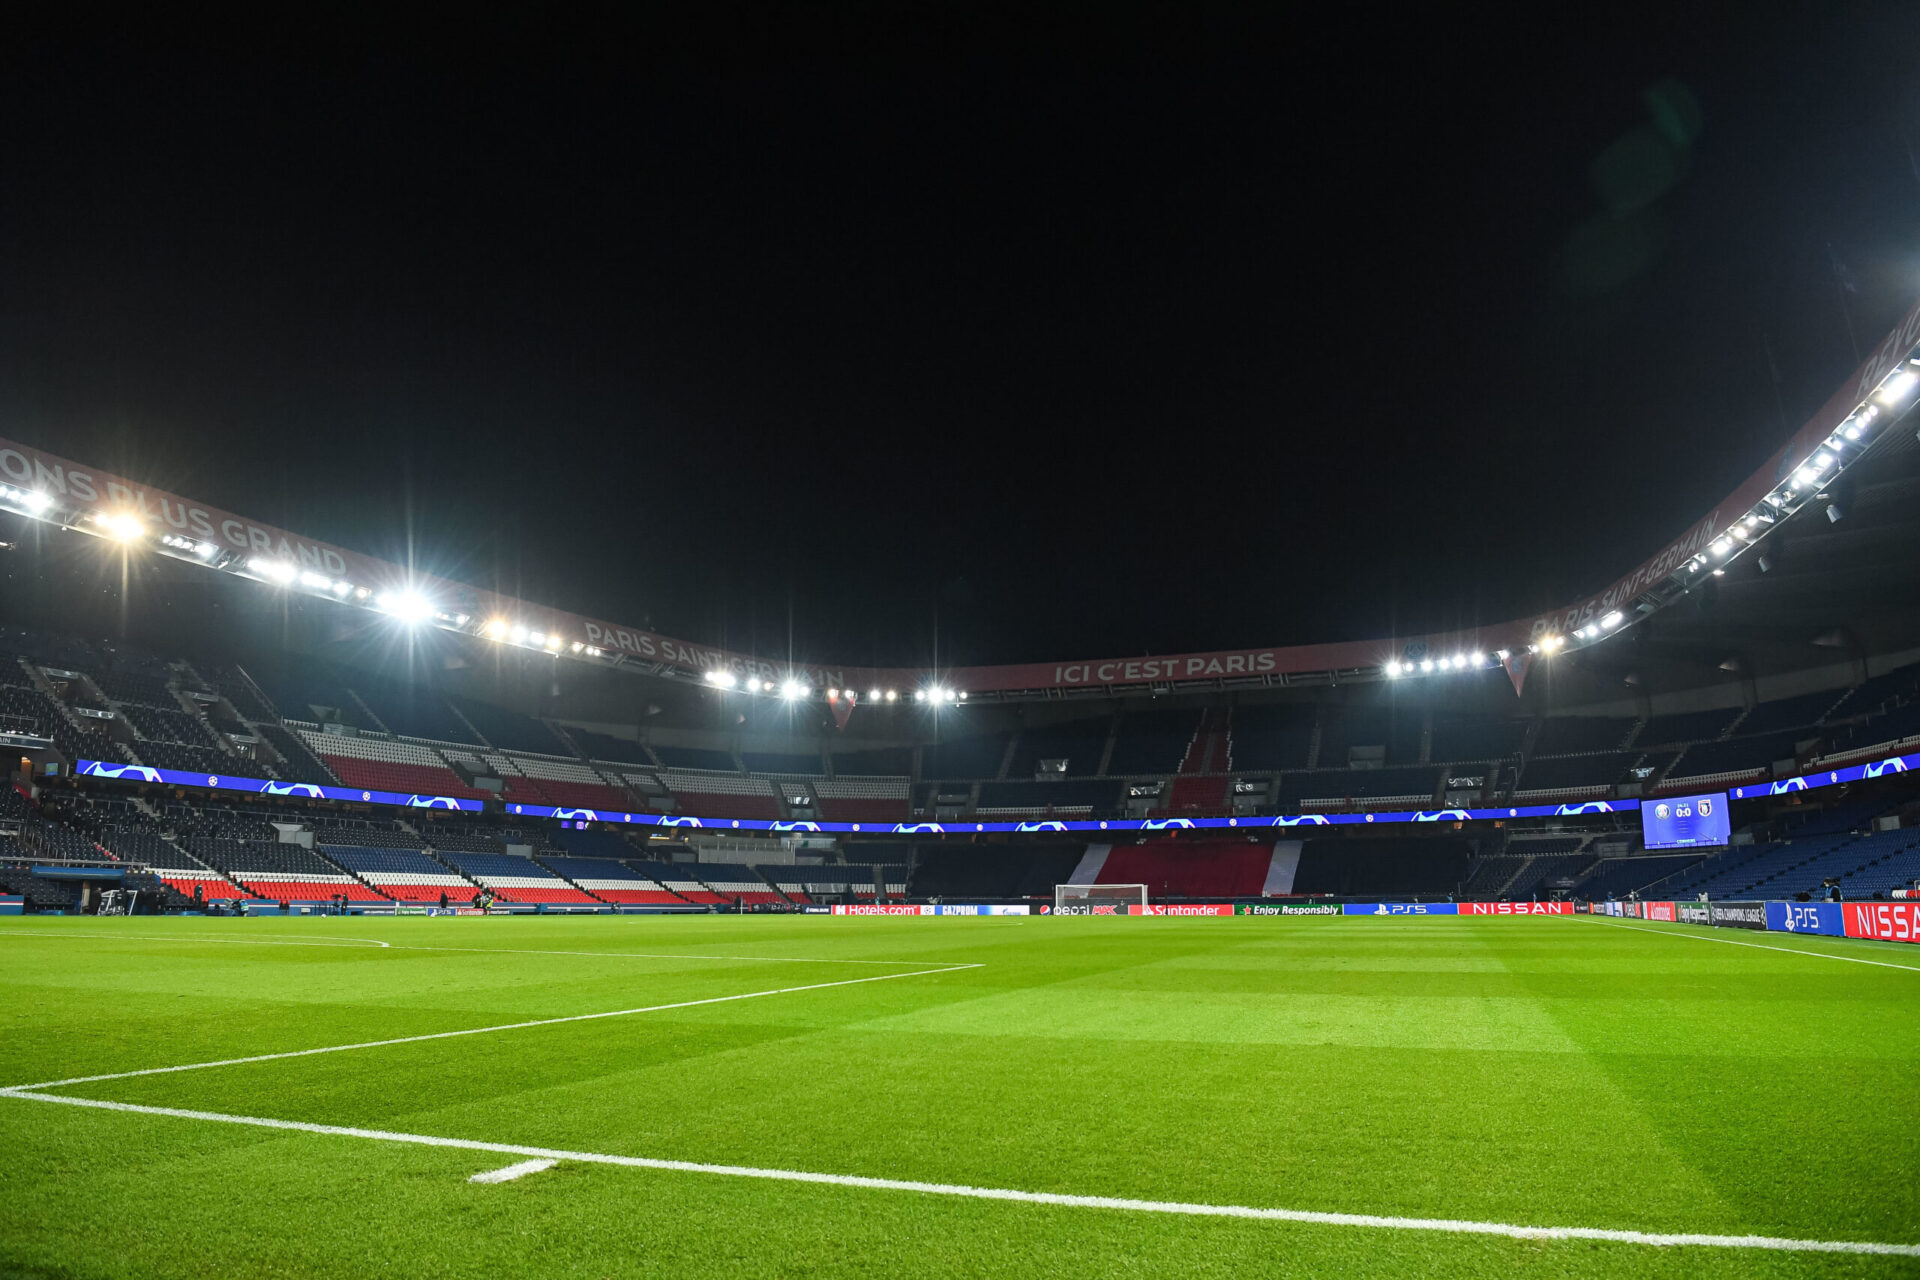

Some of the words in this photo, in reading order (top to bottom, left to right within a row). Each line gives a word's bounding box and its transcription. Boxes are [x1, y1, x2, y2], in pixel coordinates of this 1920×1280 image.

[0, 449, 98, 501] ONS
[221, 519, 347, 577] GRAND
[1530, 600, 1597, 641] PARIS
[1598, 510, 1720, 613] SAINT-GERMAIN
[584, 622, 656, 656] PARIS
[661, 641, 844, 688] SAINTGERAIN
[1055, 665, 1090, 684] ICI
[1097, 659, 1180, 681] C'EST
[1186, 653, 1277, 677] PARIS
[849, 905, 915, 916] Hotels.com
[942, 905, 978, 916] GAZPROM
[1053, 904, 1090, 916] pepsi
[1092, 904, 1118, 916] MAX
[1155, 905, 1220, 916] Santander
[1253, 905, 1280, 916] Enjoy
[1282, 904, 1339, 916] Responsibly
[1392, 905, 1428, 914] PS5
[1473, 903, 1562, 915] NISSAN
[1794, 907, 1819, 929] PS5
